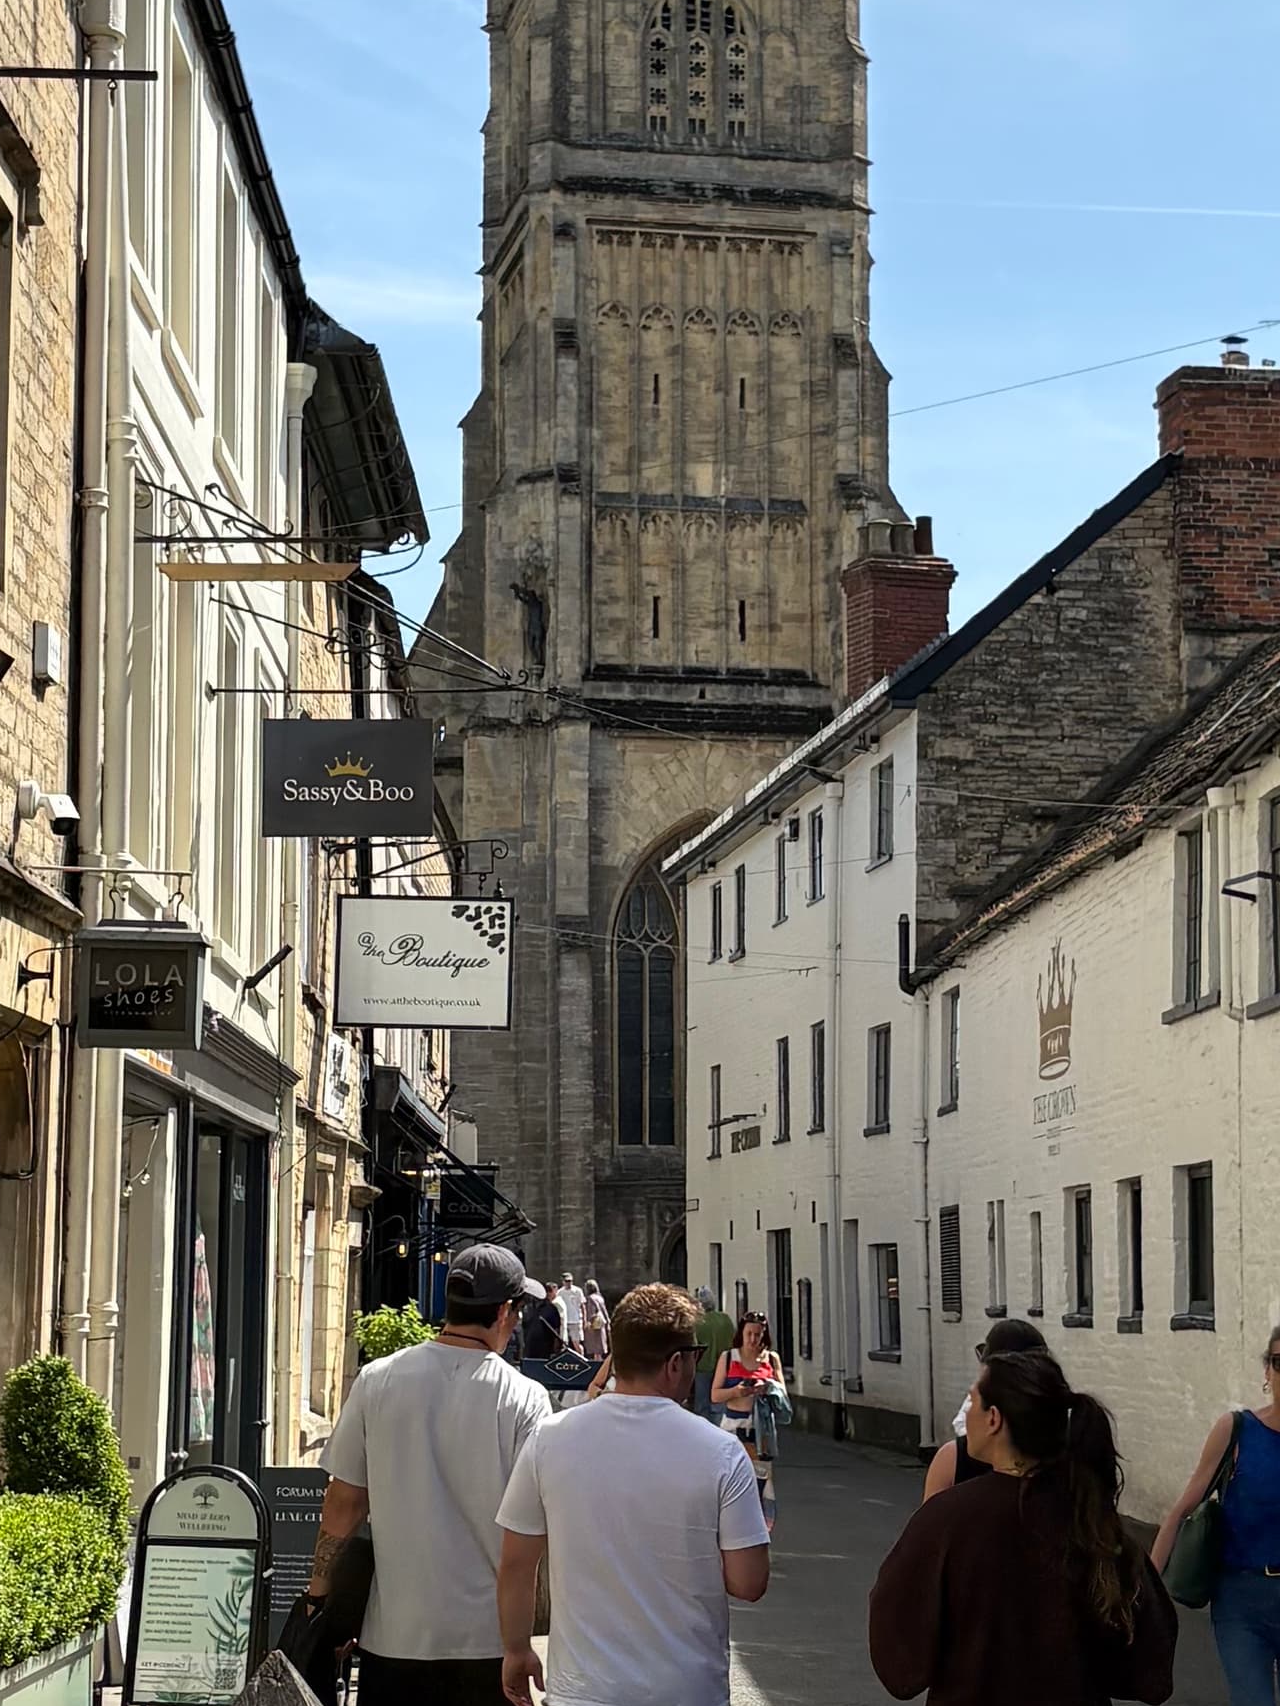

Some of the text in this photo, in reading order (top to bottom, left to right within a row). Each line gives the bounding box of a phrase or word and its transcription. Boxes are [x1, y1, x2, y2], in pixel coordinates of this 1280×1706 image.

[384, 933, 491, 979] Boutique
[95, 962, 184, 987] LOLA
[103, 987, 174, 1008] shoes
